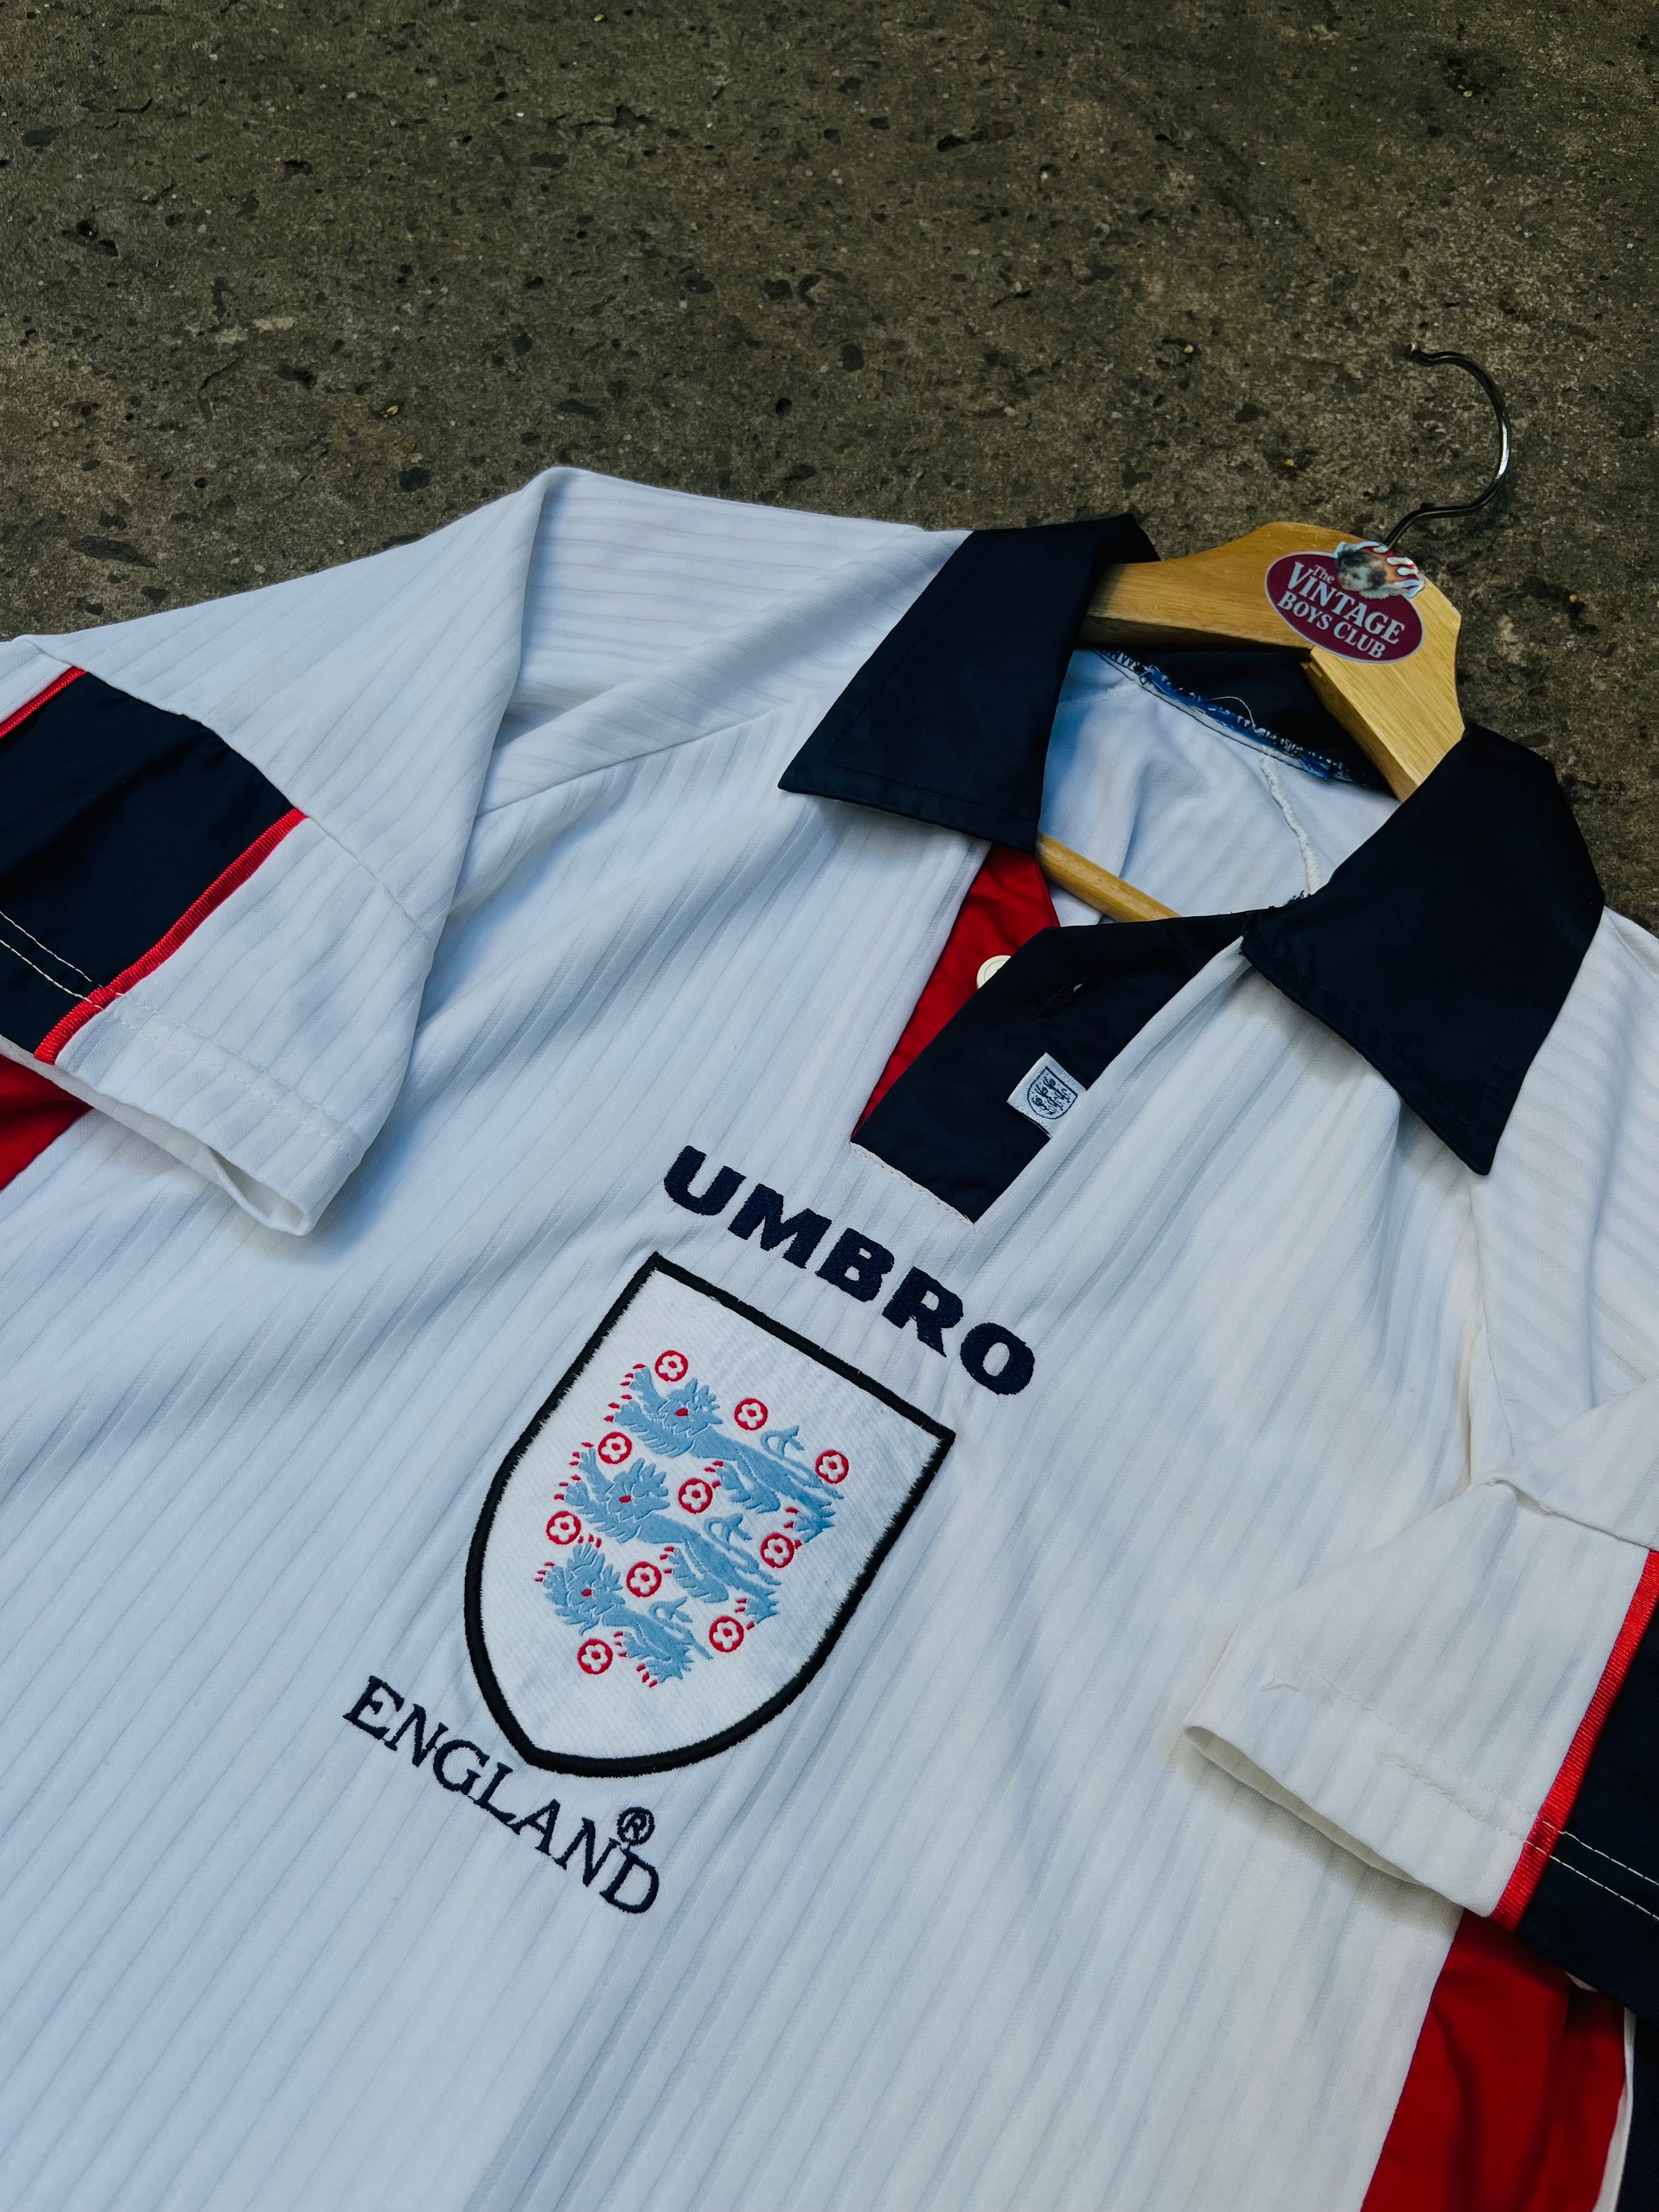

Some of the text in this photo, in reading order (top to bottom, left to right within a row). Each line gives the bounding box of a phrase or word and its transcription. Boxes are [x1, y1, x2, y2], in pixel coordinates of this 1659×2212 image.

[1286, 561, 1406, 645] VINTAGE
[1313, 564, 1335, 584] The
[1277, 591, 1387, 659] BOYS CLUB
[663, 1145, 1035, 1395] UMBRO
[342, 1675, 659, 1914] ENGLAND
